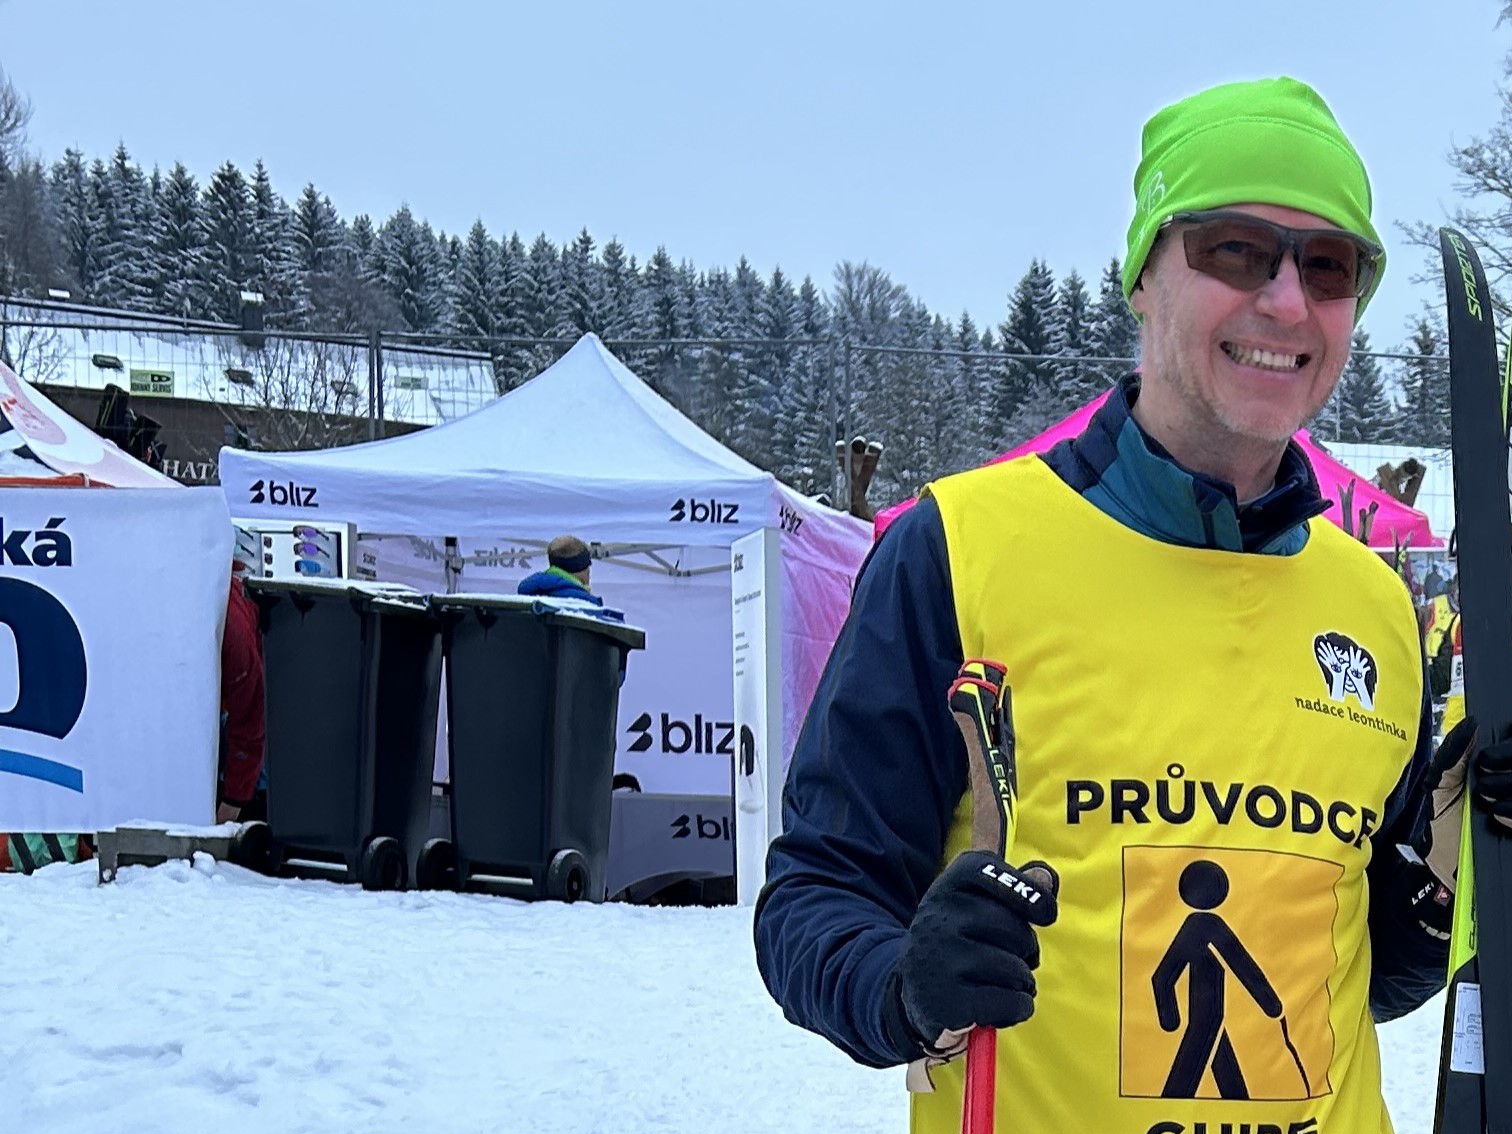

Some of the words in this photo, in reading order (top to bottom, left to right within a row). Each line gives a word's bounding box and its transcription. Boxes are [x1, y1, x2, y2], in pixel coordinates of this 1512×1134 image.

[269, 481, 319, 508] bliz
[690, 499, 739, 524] bliz
[661, 712, 735, 754] bliz
[1295, 697, 1344, 718] nadace
[1347, 707, 1407, 741] leontinka
[988, 749, 1011, 800] LEKI
[696, 814, 730, 841] bl
[1066, 763, 1379, 851] PRŮVODCE
[982, 864, 1042, 904] LEKI
